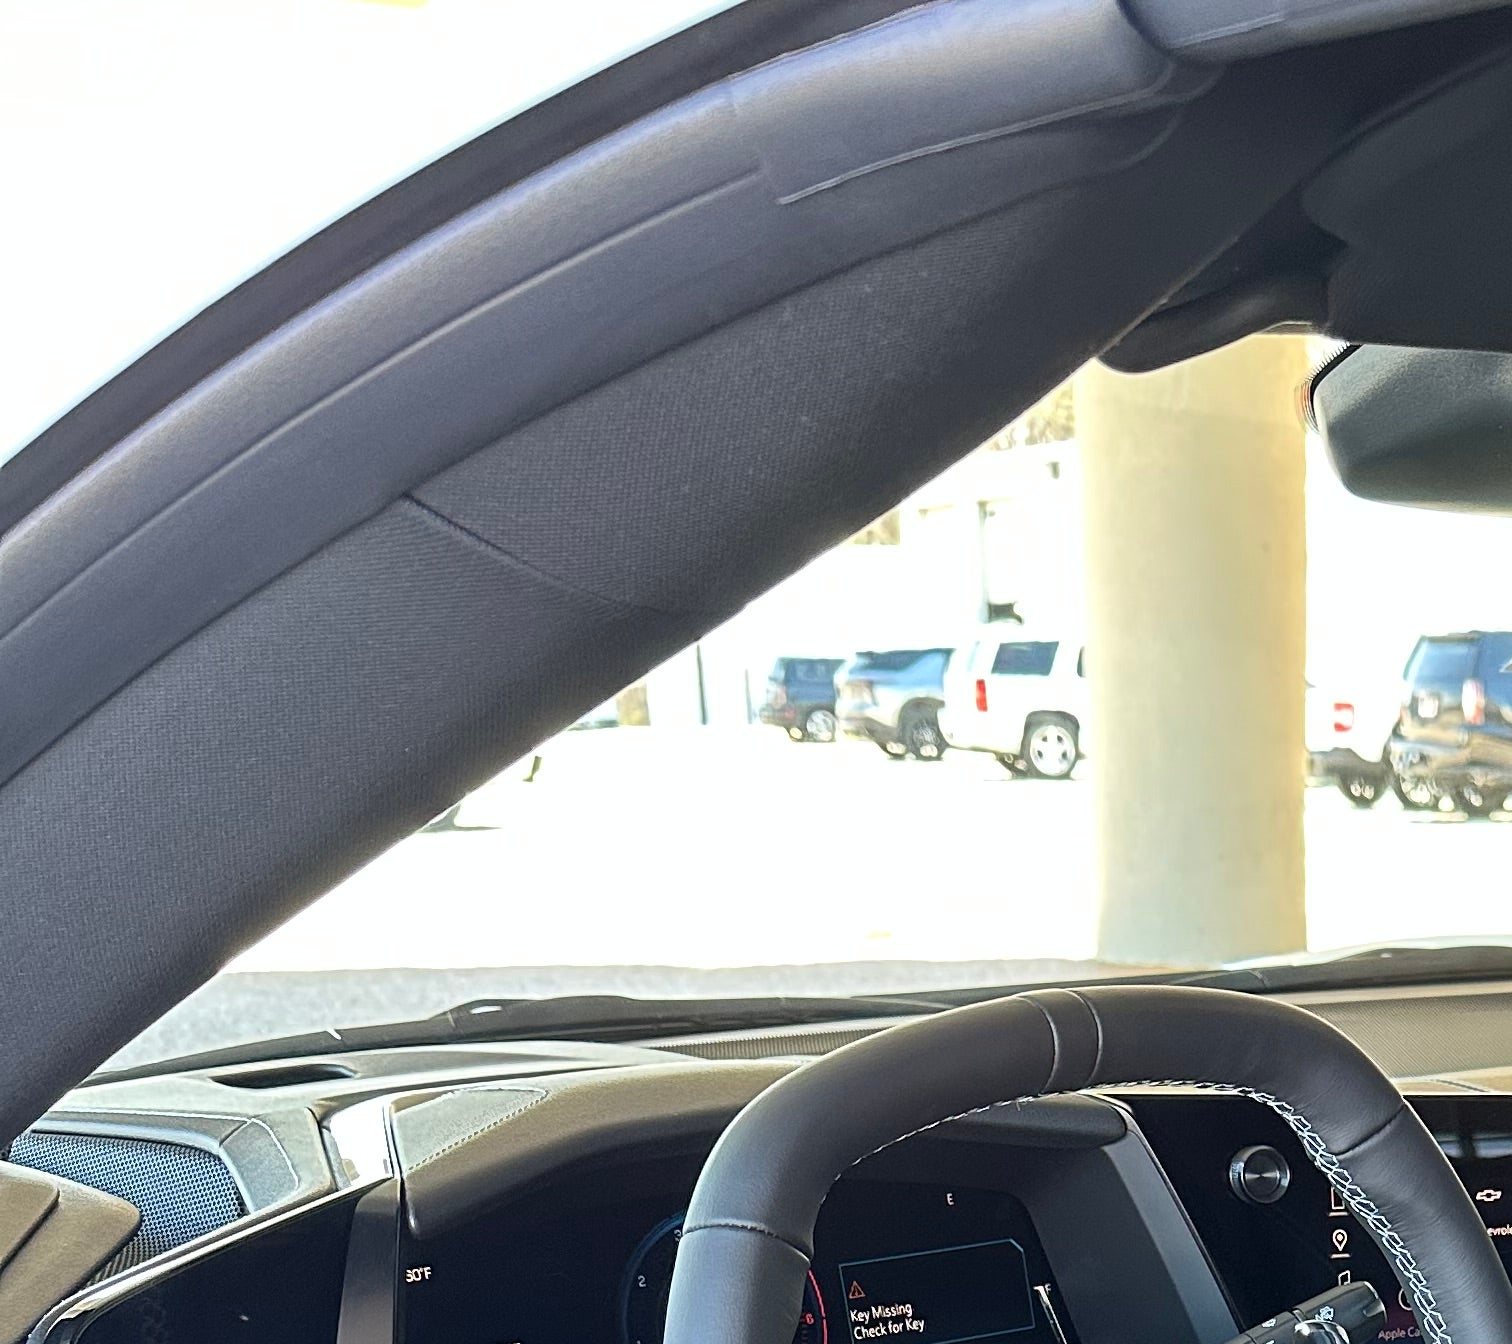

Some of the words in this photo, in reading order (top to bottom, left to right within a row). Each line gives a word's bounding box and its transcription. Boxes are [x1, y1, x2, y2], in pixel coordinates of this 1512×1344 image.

[946, 1193, 954, 1205] E
[638, 1275, 646, 1288] 2
[850, 1309, 870, 1325] Key
[871, 1303, 912, 1319] Missing
[854, 1322, 888, 1340] Check
[888, 1320, 904, 1334] for
[905, 1317, 925, 1333] Key
[1378, 1327, 1406, 1341] Apple
